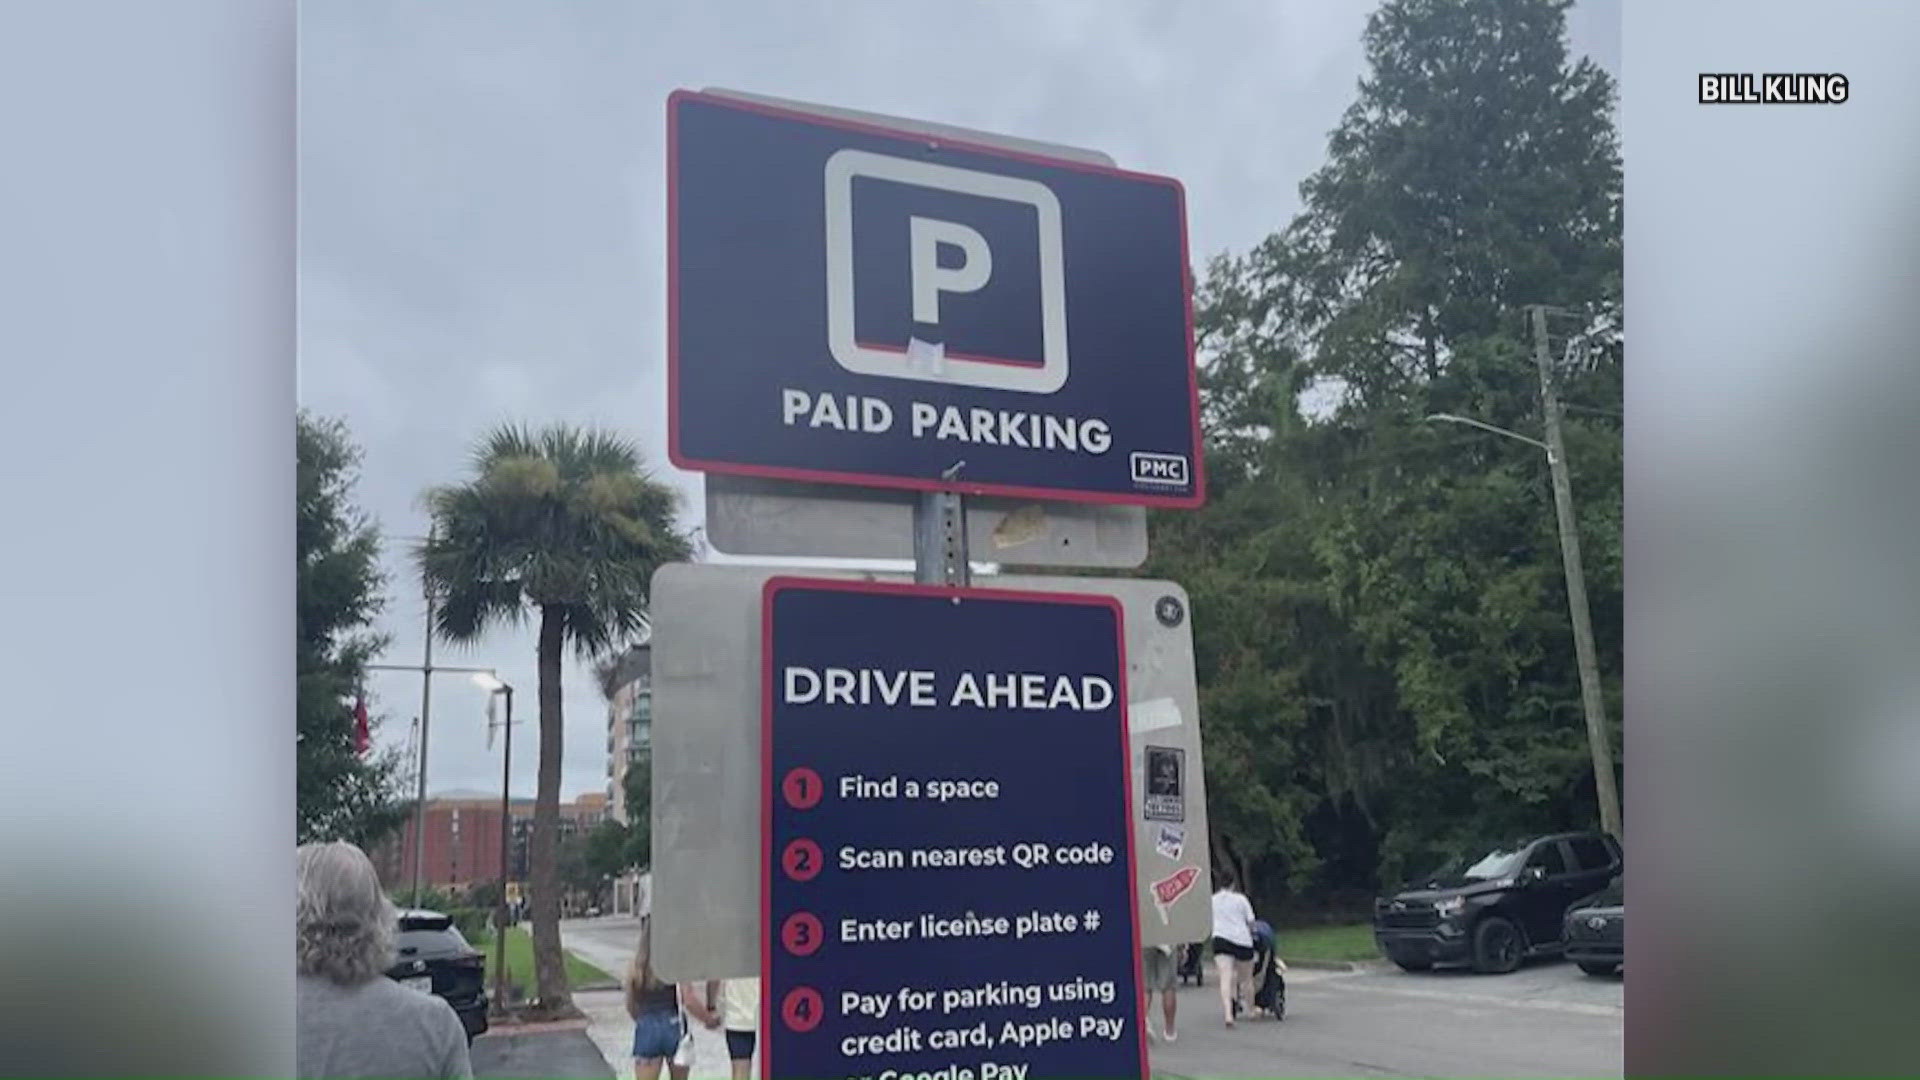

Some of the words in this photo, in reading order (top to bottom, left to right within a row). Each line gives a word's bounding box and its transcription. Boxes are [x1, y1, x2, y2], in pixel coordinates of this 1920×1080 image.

[910, 215, 992, 324] P
[782, 388, 893, 434] PAID
[911, 402, 1112, 454] PARKING
[1140, 459, 1180, 478] PMC
[784, 667, 937, 706] DRIVE
[950, 673, 1114, 711] AHEAD
[840, 776, 897, 798] Find
[905, 781, 920, 798] a
[927, 781, 999, 801] space
[839, 847, 903, 869] Scan
[912, 844, 1006, 866] nearest
[1012, 843, 1050, 867] QR
[1055, 842, 1114, 864] code
[841, 917, 913, 942] Enter
[920, 913, 1009, 938] license
[1016, 910, 1077, 939] plate
[1084, 911, 1100, 931] #
[841, 990, 892, 1018] Pay
[898, 986, 934, 1011] for
[943, 981, 1042, 1011] parking
[1048, 978, 1116, 1003] using
[841, 1027, 921, 1056] credit
[928, 1021, 994, 1050] card,
[1000, 1014, 1073, 1045] Apple
[1080, 1014, 1124, 1041] Pay
